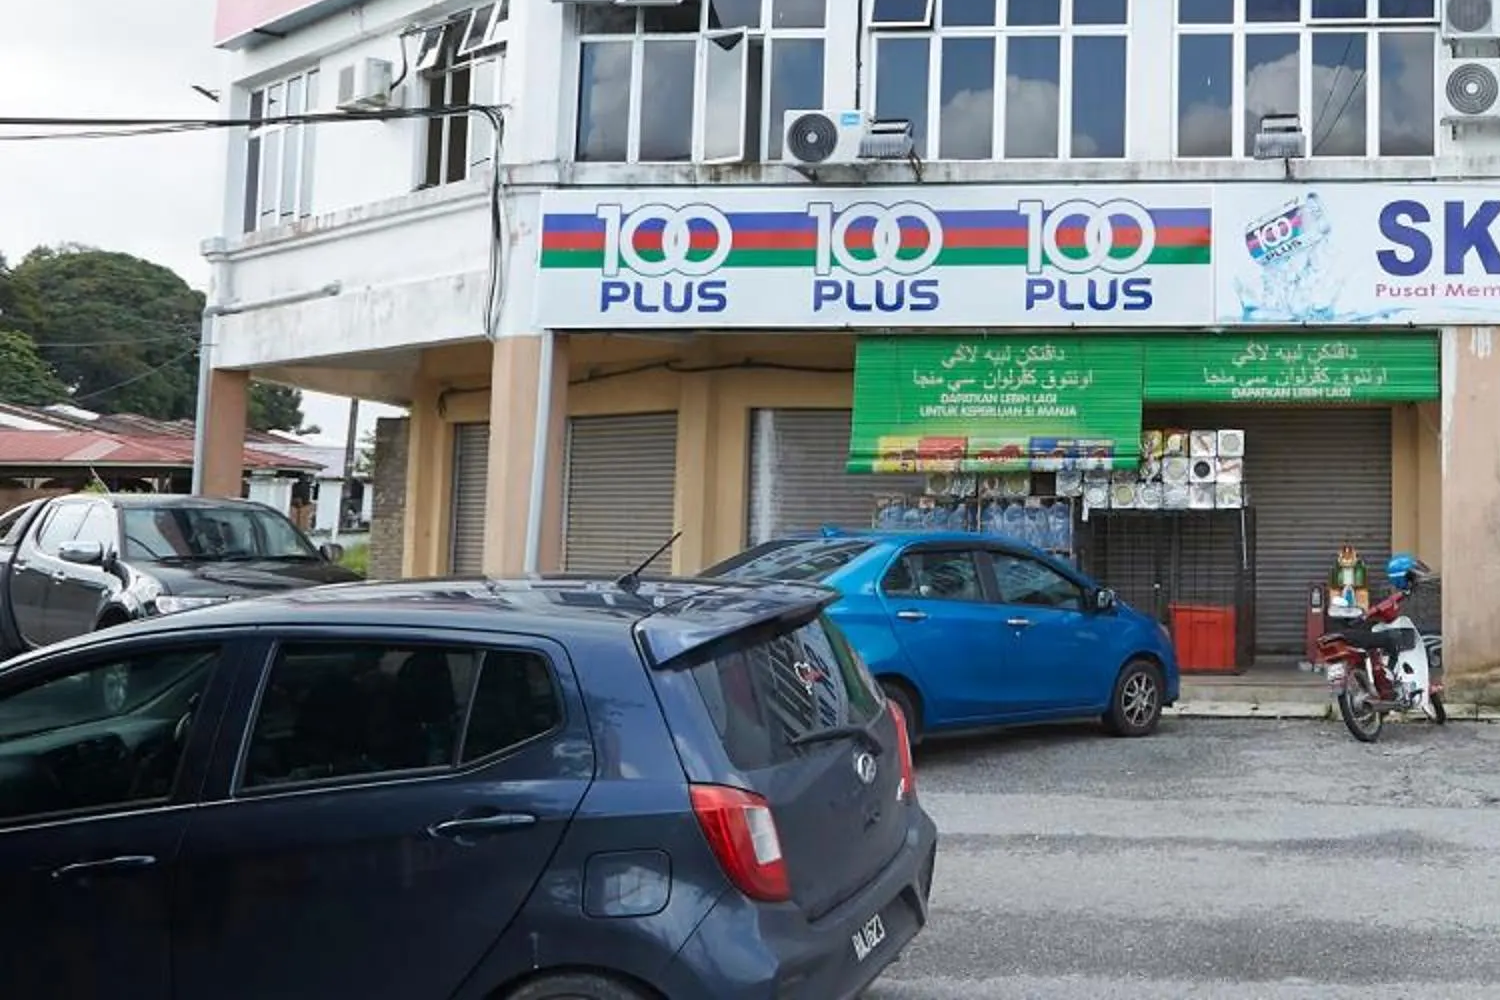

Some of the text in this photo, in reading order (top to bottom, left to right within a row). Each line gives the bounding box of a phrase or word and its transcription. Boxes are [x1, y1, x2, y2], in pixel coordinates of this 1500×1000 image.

[596, 202, 733, 278] 100
[807, 200, 943, 277] 100
[1018, 198, 1156, 275] 100
[600, 280, 727, 313] PLUS
[813, 278, 940, 312] PLUS
[1025, 276, 1153, 311] PLUS
[1375, 284, 1437, 298] Pusat
